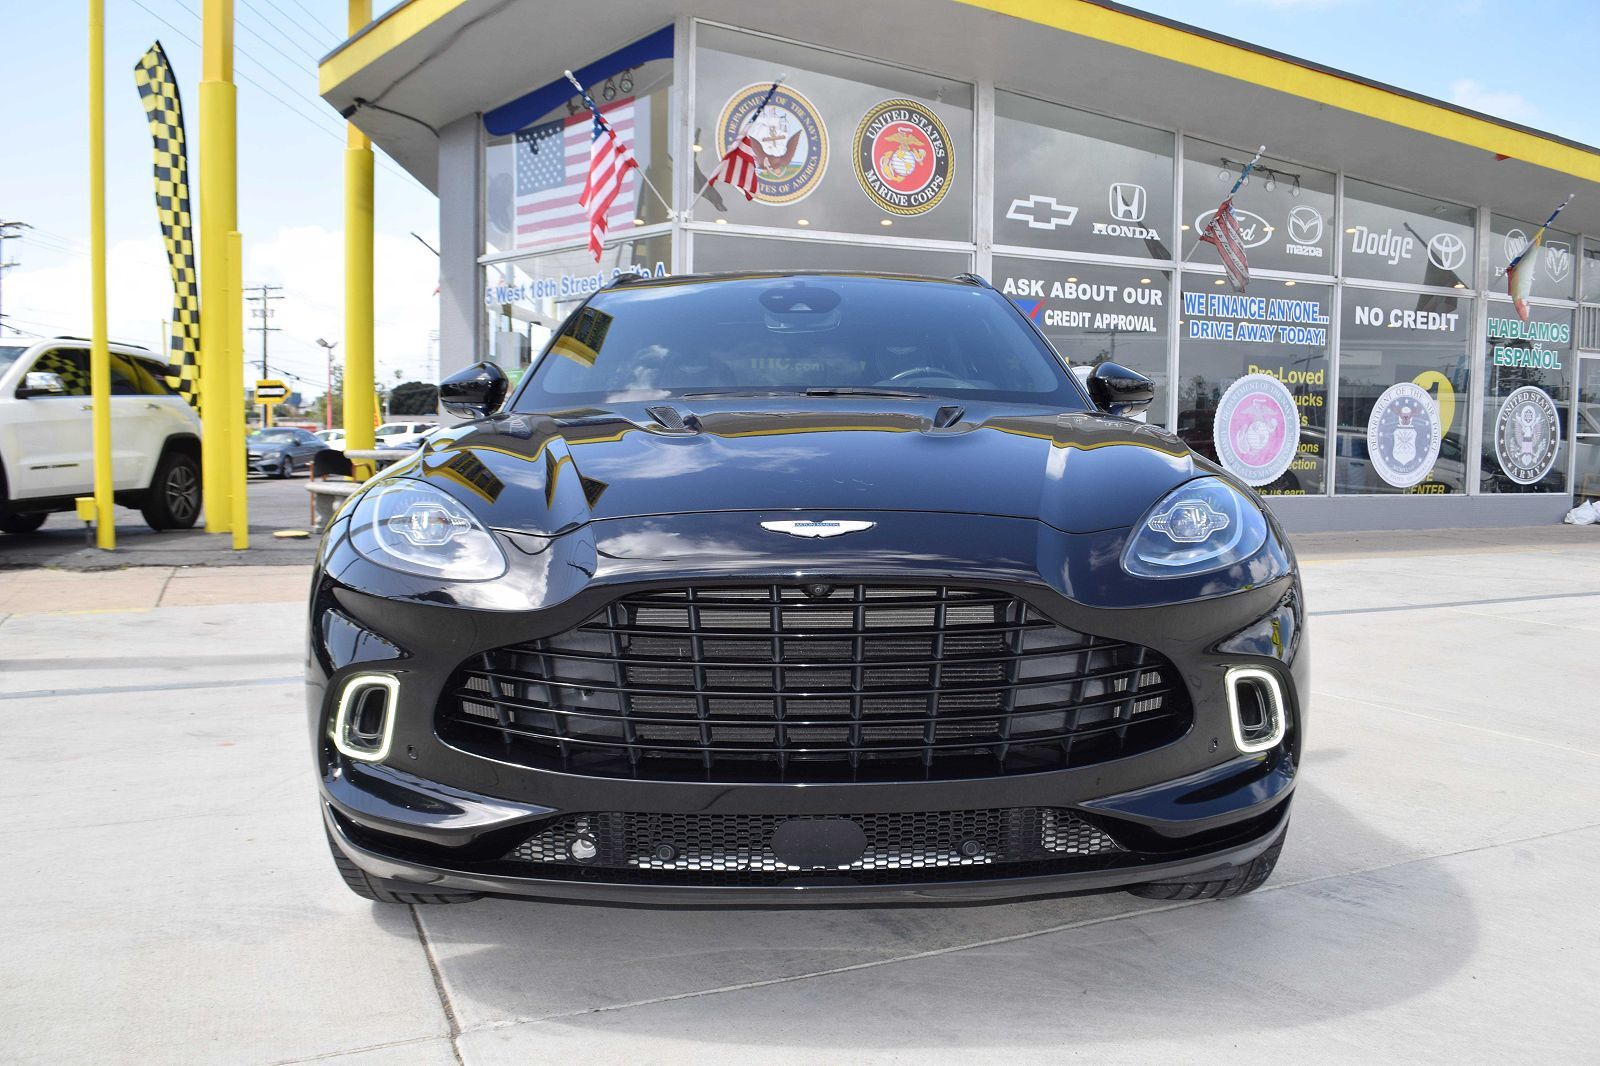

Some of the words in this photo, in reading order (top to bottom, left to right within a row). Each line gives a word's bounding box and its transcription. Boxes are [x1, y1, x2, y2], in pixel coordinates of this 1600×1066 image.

[728, 95, 771, 134] DEPARTMEN
[775, 95, 787, 105] OF
[791, 102, 806, 118] THE
[805, 117, 819, 142] NAVY
[866, 110, 910, 140] UNITED
[911, 113, 945, 158] STATES
[778, 184, 792, 192] OF
[791, 155, 818, 190] AMERICA
[865, 168, 908, 206] MARINE
[911, 175, 944, 206] CORPS
[1092, 222, 1161, 241] HONDA
[1352, 225, 1414, 265] Dodge
[496, 285, 525, 303] West
[530, 280, 557, 298] 18th
[1002, 277, 1046, 298] ASK
[1050, 281, 1118, 303] ABOUT
[1123, 287, 1163, 306] OUR
[1044, 309, 1092, 328] CREDIT
[1094, 313, 1157, 332] APPROVAL
[1183, 291, 1206, 315] WE
[1208, 293, 1266, 320] FINANCE
[1267, 299, 1329, 324] ANYONE...
[1355, 305, 1384, 326] NO
[1389, 310, 1459, 332] CREDIT
[1189, 320, 1233, 340] DRIVE
[1236, 324, 1277, 343] AWAY
[1278, 326, 1326, 346] TODAY!
[1487, 318, 1569, 343] HABLAMOS
[1494, 343, 1562, 370] ESPAÑOL
[1395, 388, 1406, 396] OF
[1502, 392, 1530, 422] UNITED
[1530, 392, 1555, 424] STATES
[1511, 466, 1541, 478] ARMY
